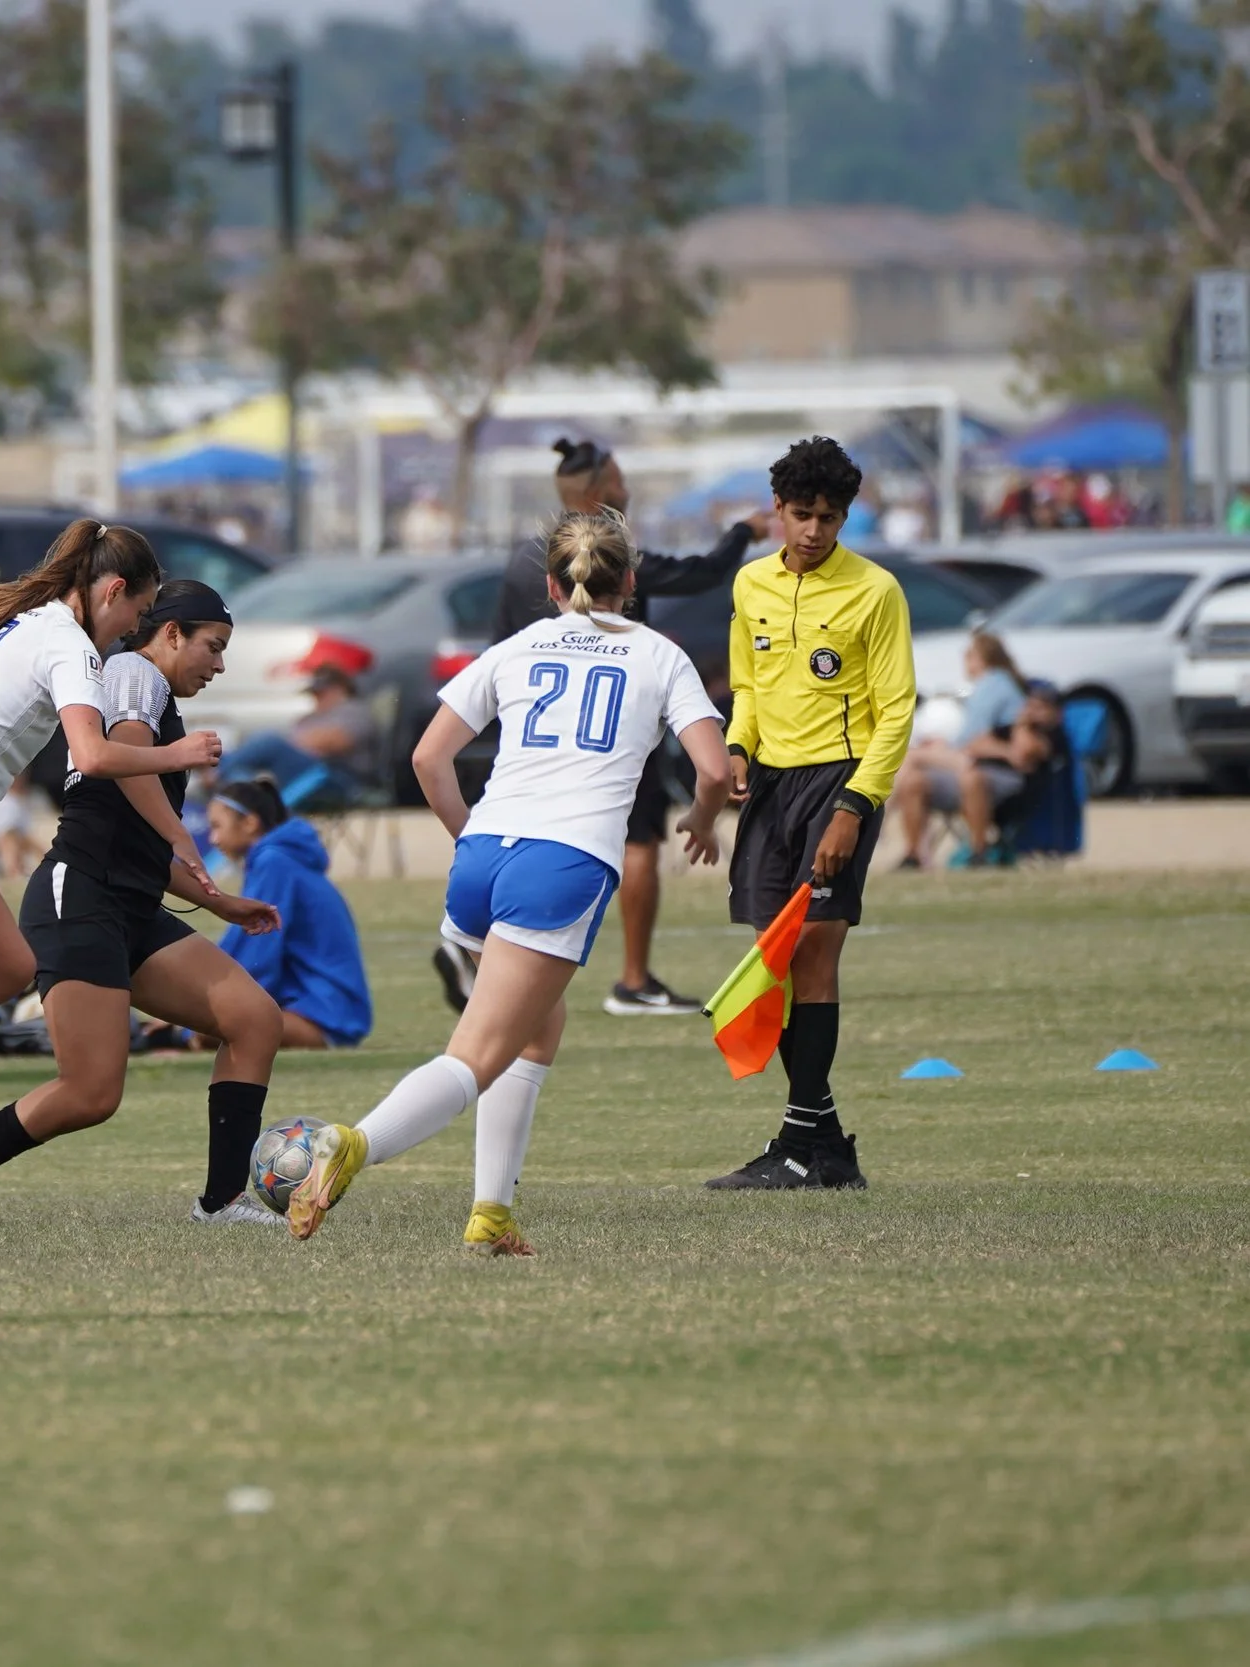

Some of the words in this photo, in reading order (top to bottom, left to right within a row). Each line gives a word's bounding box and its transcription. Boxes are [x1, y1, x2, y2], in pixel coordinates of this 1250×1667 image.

[531, 641, 561, 650] LOS
[561, 643, 631, 656] ANGELES
[521, 662, 627, 753] 20
